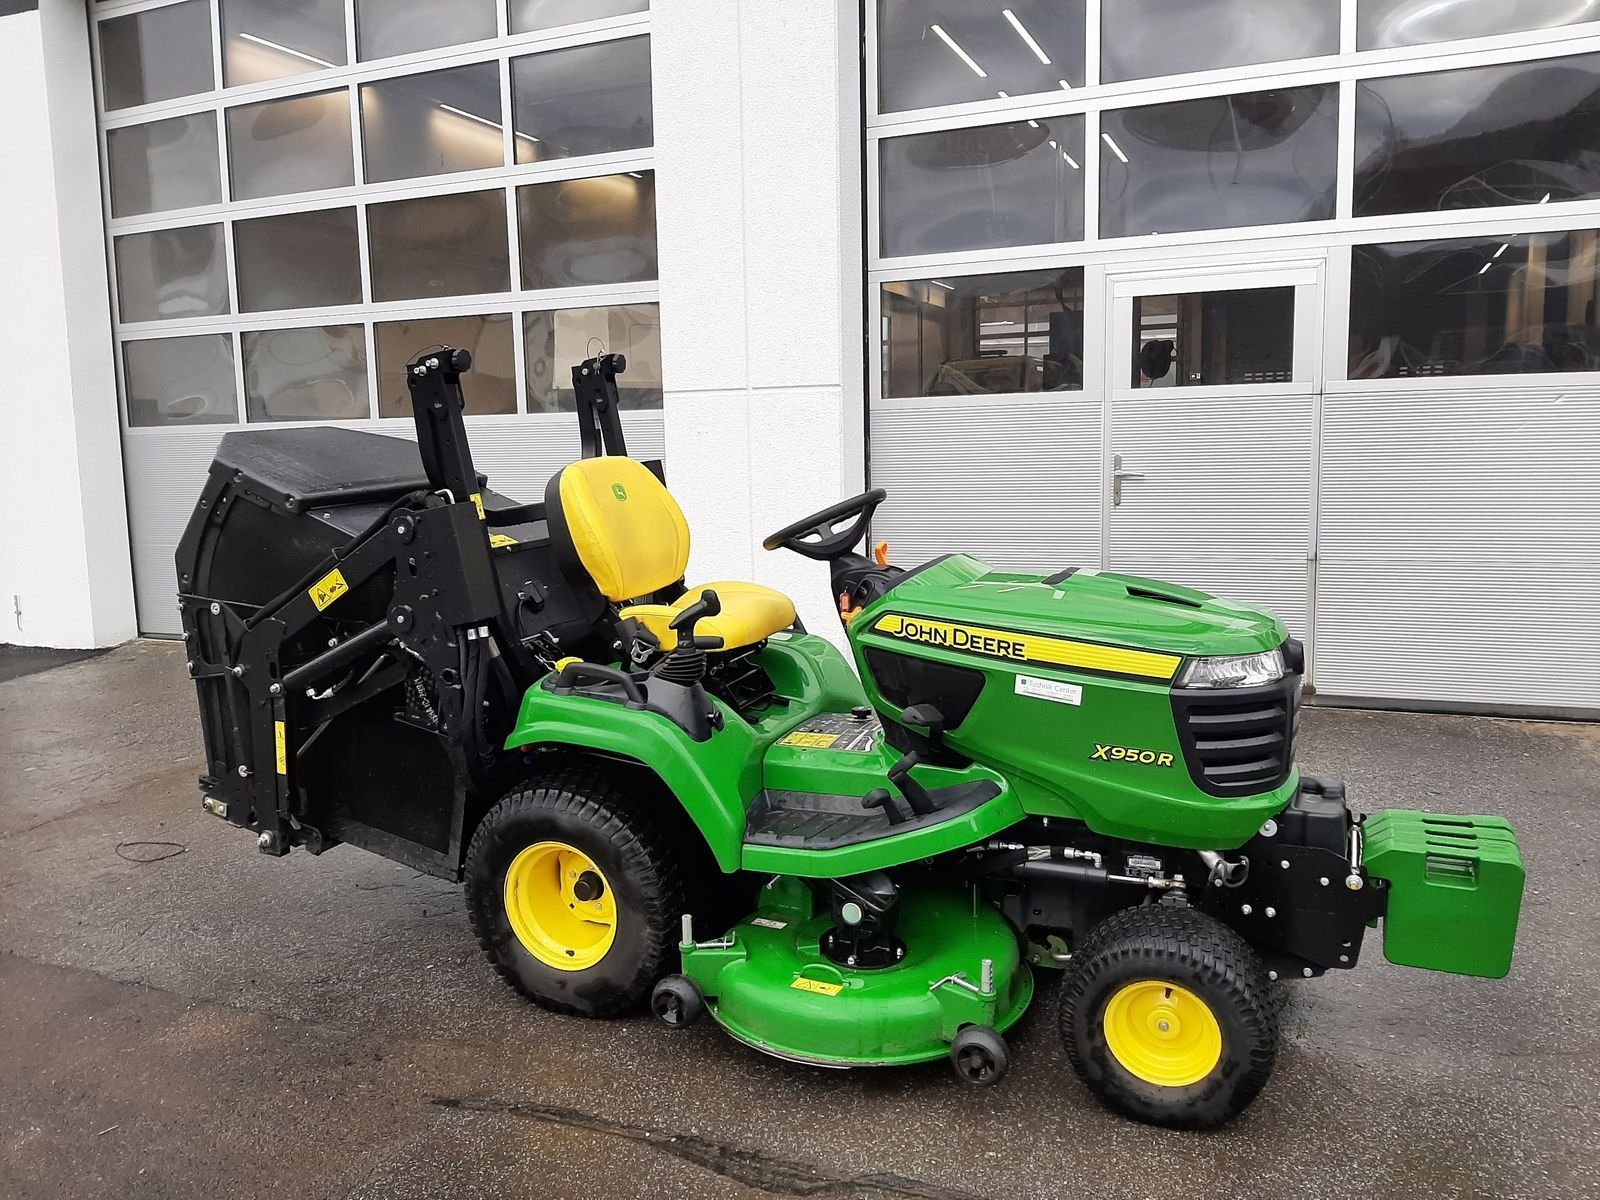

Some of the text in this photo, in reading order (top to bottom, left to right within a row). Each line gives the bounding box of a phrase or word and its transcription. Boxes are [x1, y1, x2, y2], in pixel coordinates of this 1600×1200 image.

[894, 618, 1025, 658] JOHN DEERE
[1029, 680, 1053, 690] Technik
[1054, 685, 1077, 695] Center
